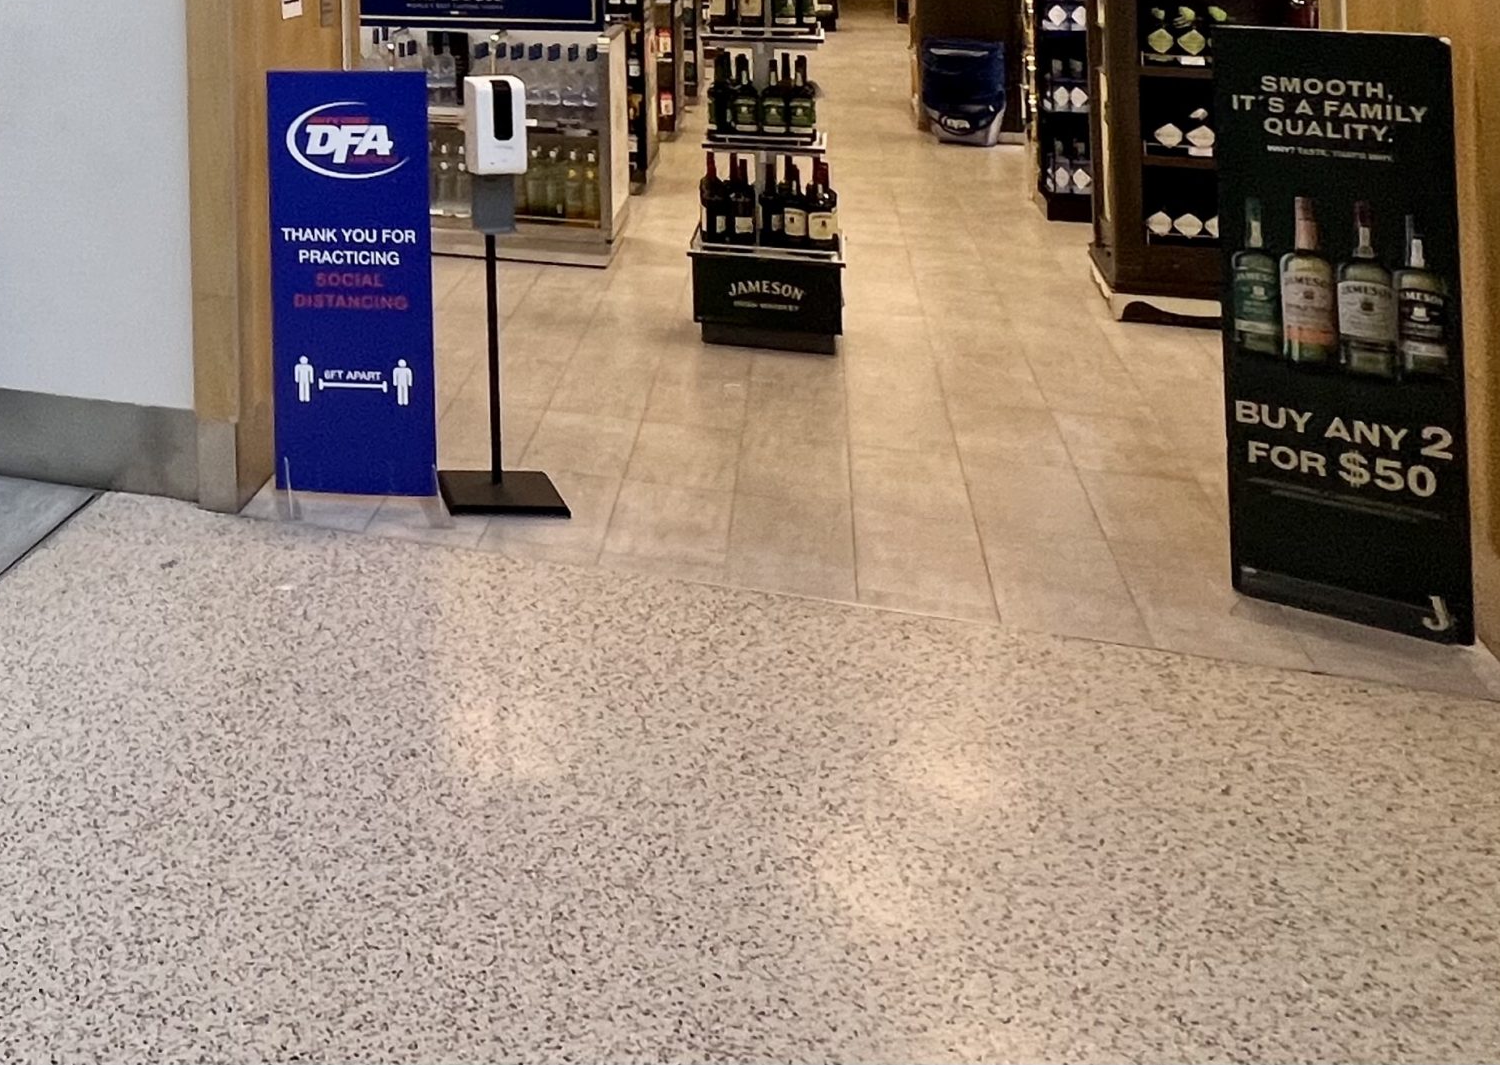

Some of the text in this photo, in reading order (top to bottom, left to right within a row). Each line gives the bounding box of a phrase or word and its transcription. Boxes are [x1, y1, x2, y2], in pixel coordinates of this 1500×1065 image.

[1260, 75, 1393, 102] SMOOTH,
[1231, 94, 1428, 123] IT'S A FAMILY
[1263, 117, 1393, 143] QUALITY.
[305, 124, 394, 164] DFA
[280, 227, 416, 244] THANK YOU FOR
[298, 249, 400, 265] PRACTICING
[315, 272, 384, 287] SOCIAL
[728, 280, 805, 301] JAMESON
[293, 294, 408, 311] DISTANCING
[346, 370, 382, 381] APART
[1235, 400, 1454, 461] BUY ANY 2
[1247, 440, 1327, 477] FOR
[1338, 450, 1438, 498] $50
